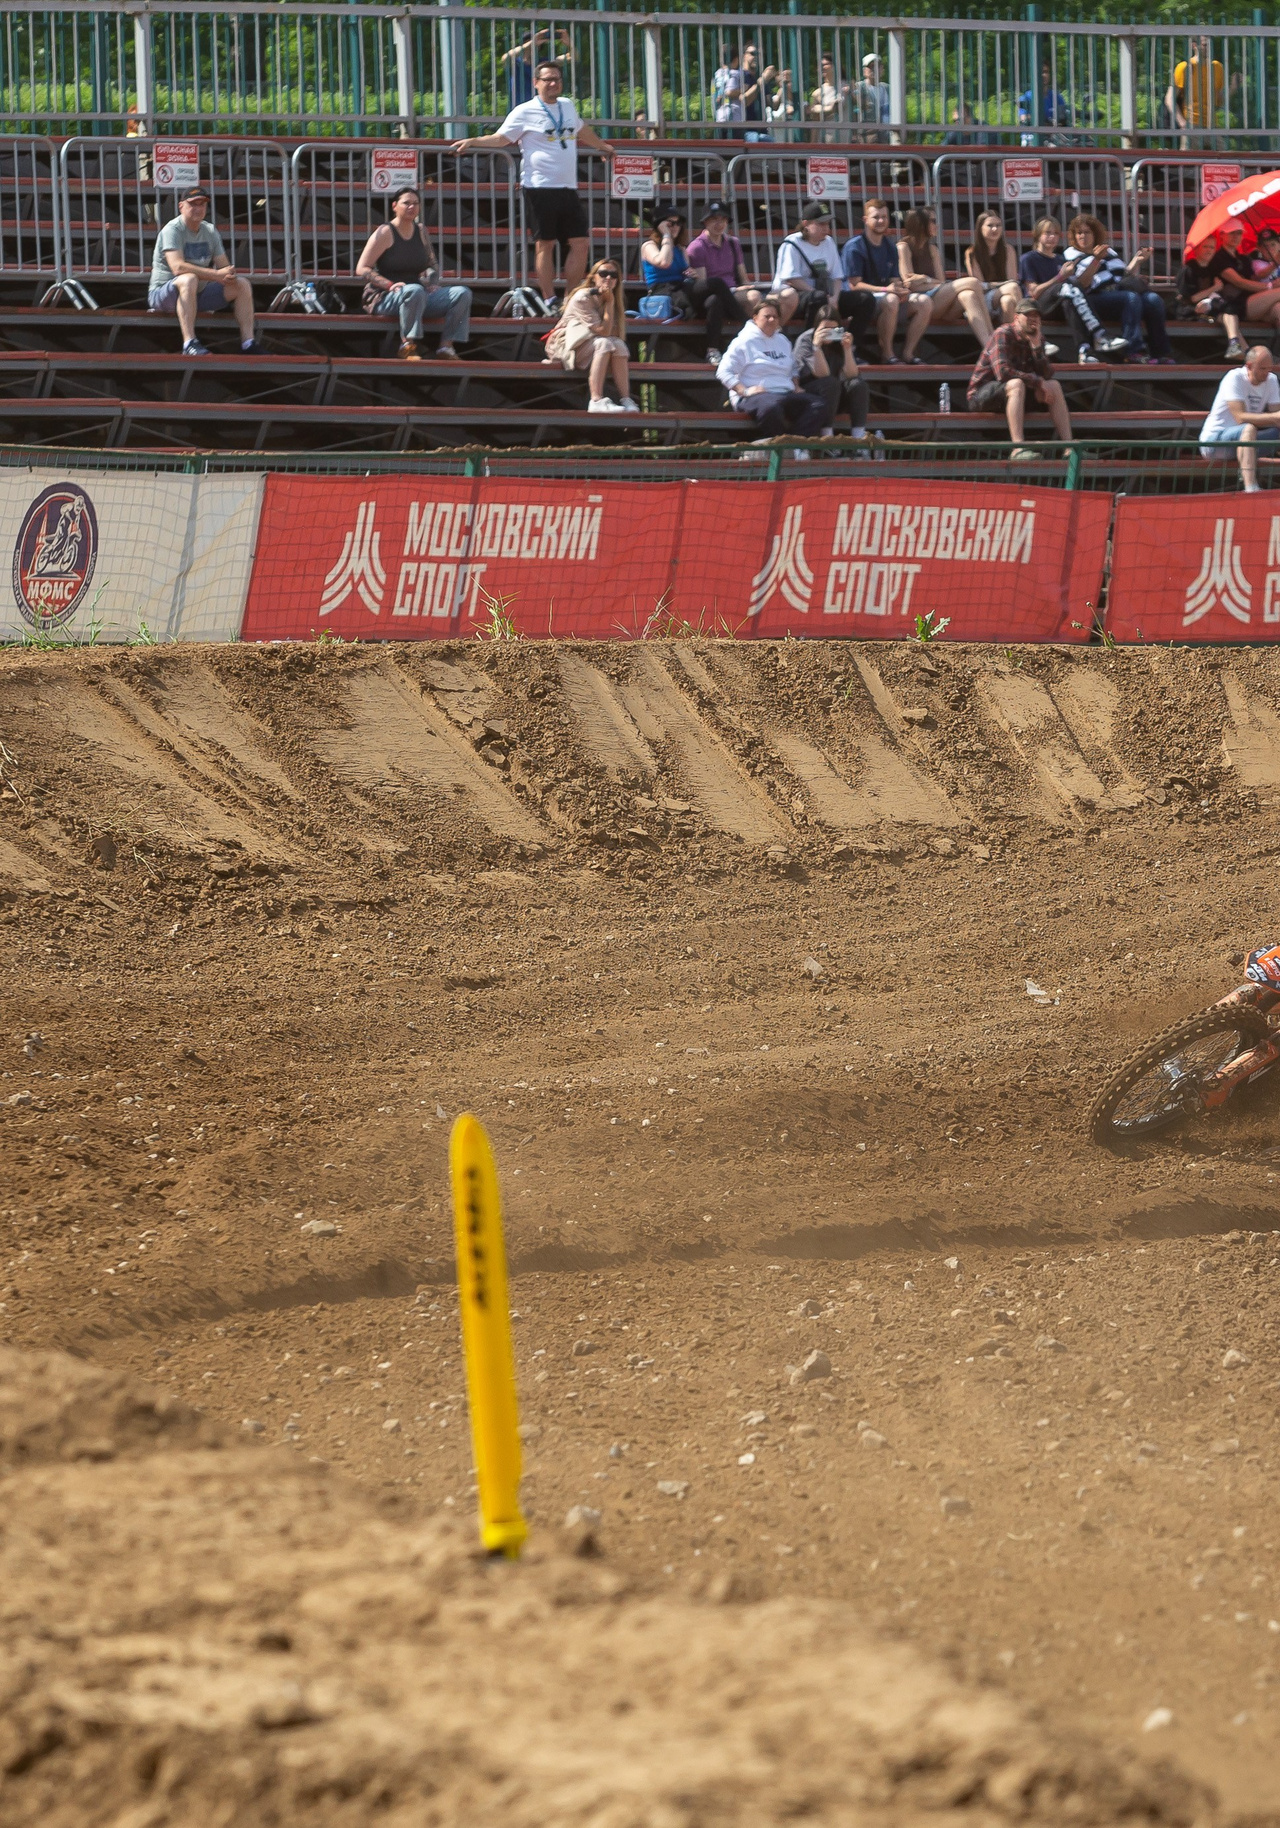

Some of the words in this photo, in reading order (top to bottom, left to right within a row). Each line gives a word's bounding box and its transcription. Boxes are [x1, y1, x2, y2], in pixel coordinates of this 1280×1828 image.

[404, 494, 603, 560] МОСКОВСКИЙ
[832, 500, 1036, 564] МОСКОВСКИЙ
[26, 580, 74, 600] МФМС
[392, 562, 488, 618] СПОРТ
[823, 562, 922, 616] СПОРТ
